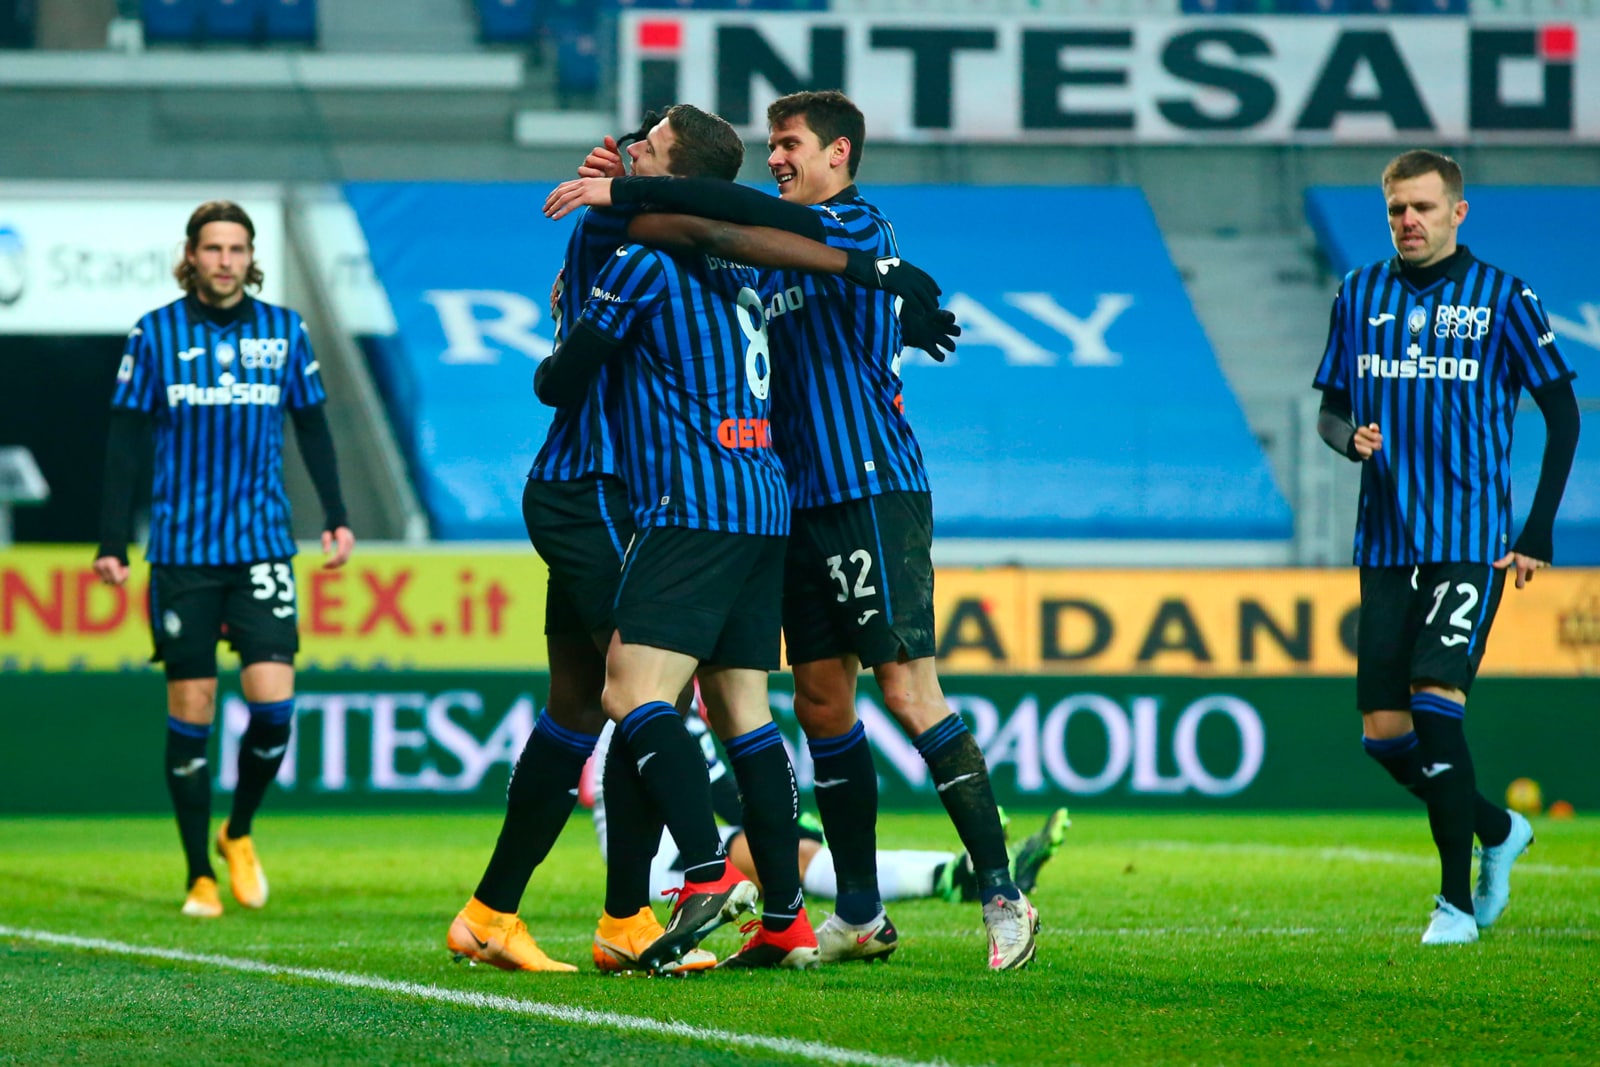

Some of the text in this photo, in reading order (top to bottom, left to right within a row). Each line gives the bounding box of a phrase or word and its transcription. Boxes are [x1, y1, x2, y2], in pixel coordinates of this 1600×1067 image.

[1434, 320, 1489, 340] GROUP
[1436, 305, 1491, 325] RADICI
[736, 287, 771, 400] 8
[1357, 353, 1479, 381] Plus500
[166, 382, 281, 408] Plus500
[250, 562, 294, 602] 33
[826, 549, 876, 602] 32
[1425, 580, 1479, 631] 72
